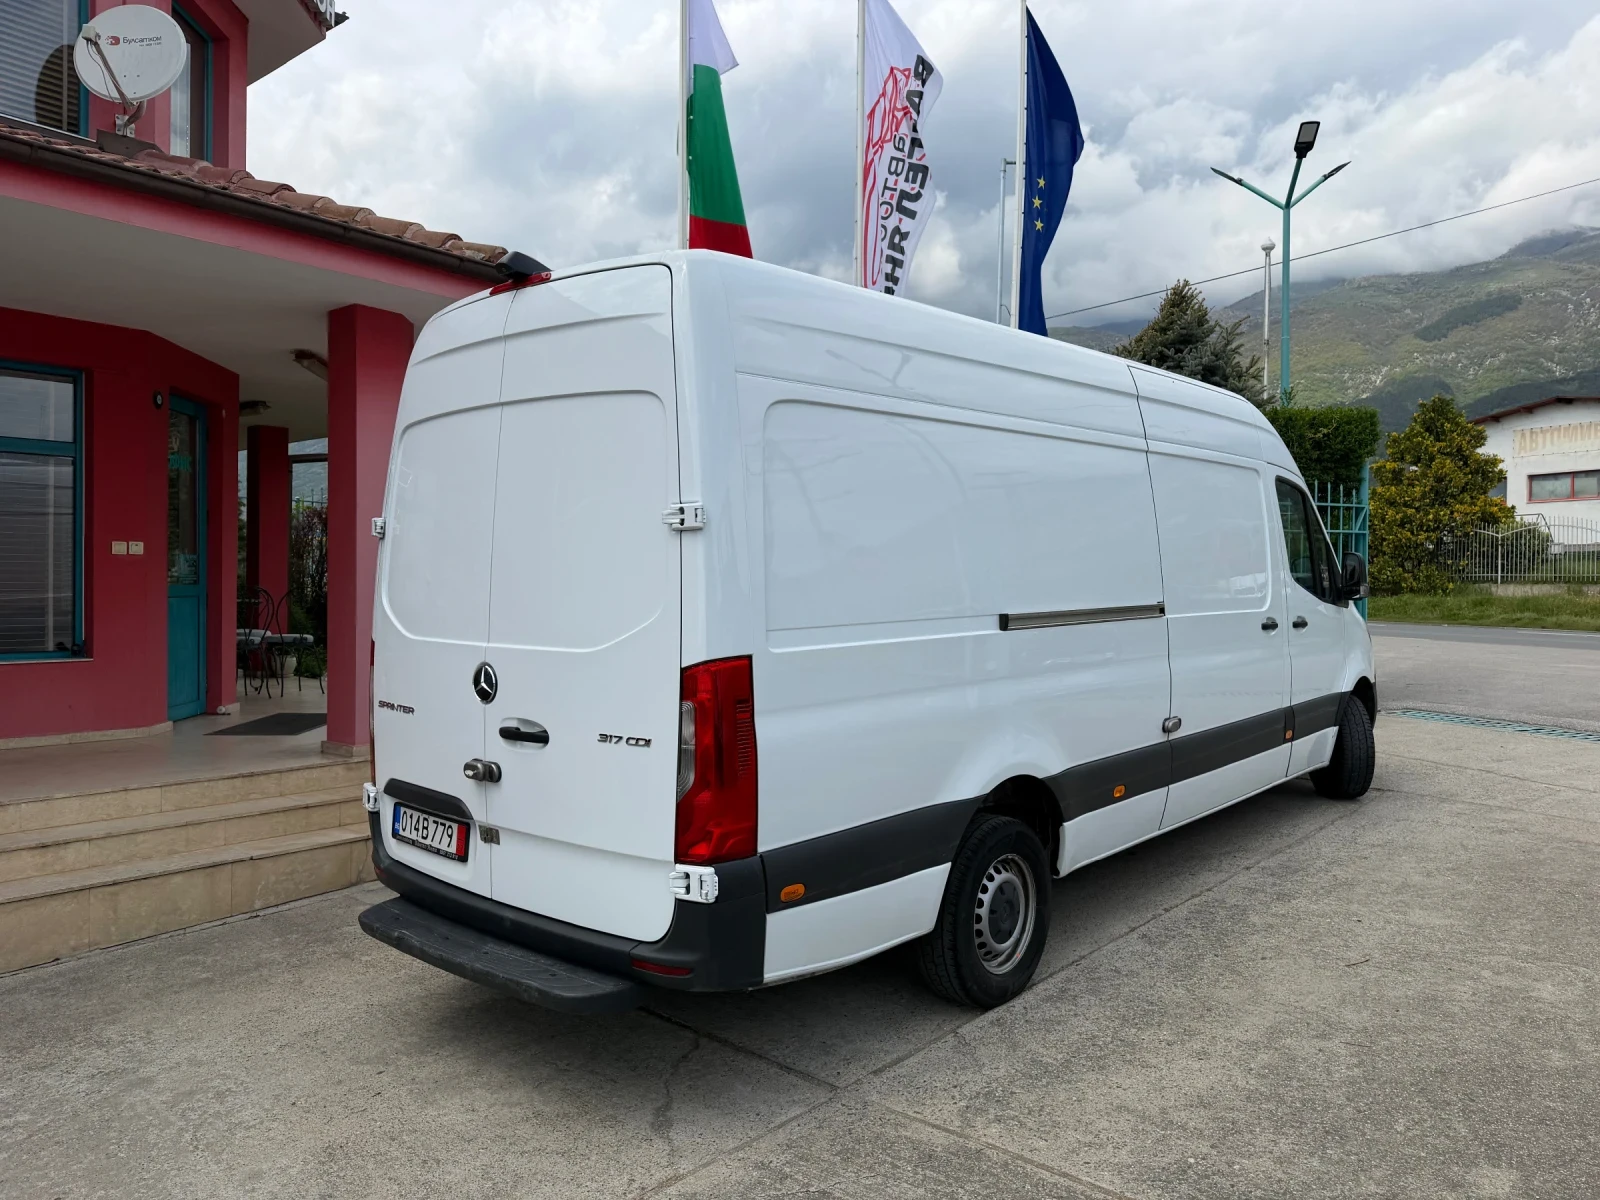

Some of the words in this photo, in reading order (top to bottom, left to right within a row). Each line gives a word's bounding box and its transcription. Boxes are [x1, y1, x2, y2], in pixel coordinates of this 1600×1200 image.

[378, 700, 415, 716] SPRINTER
[597, 733, 623, 745] 317
[625, 736, 652, 748] CDI
